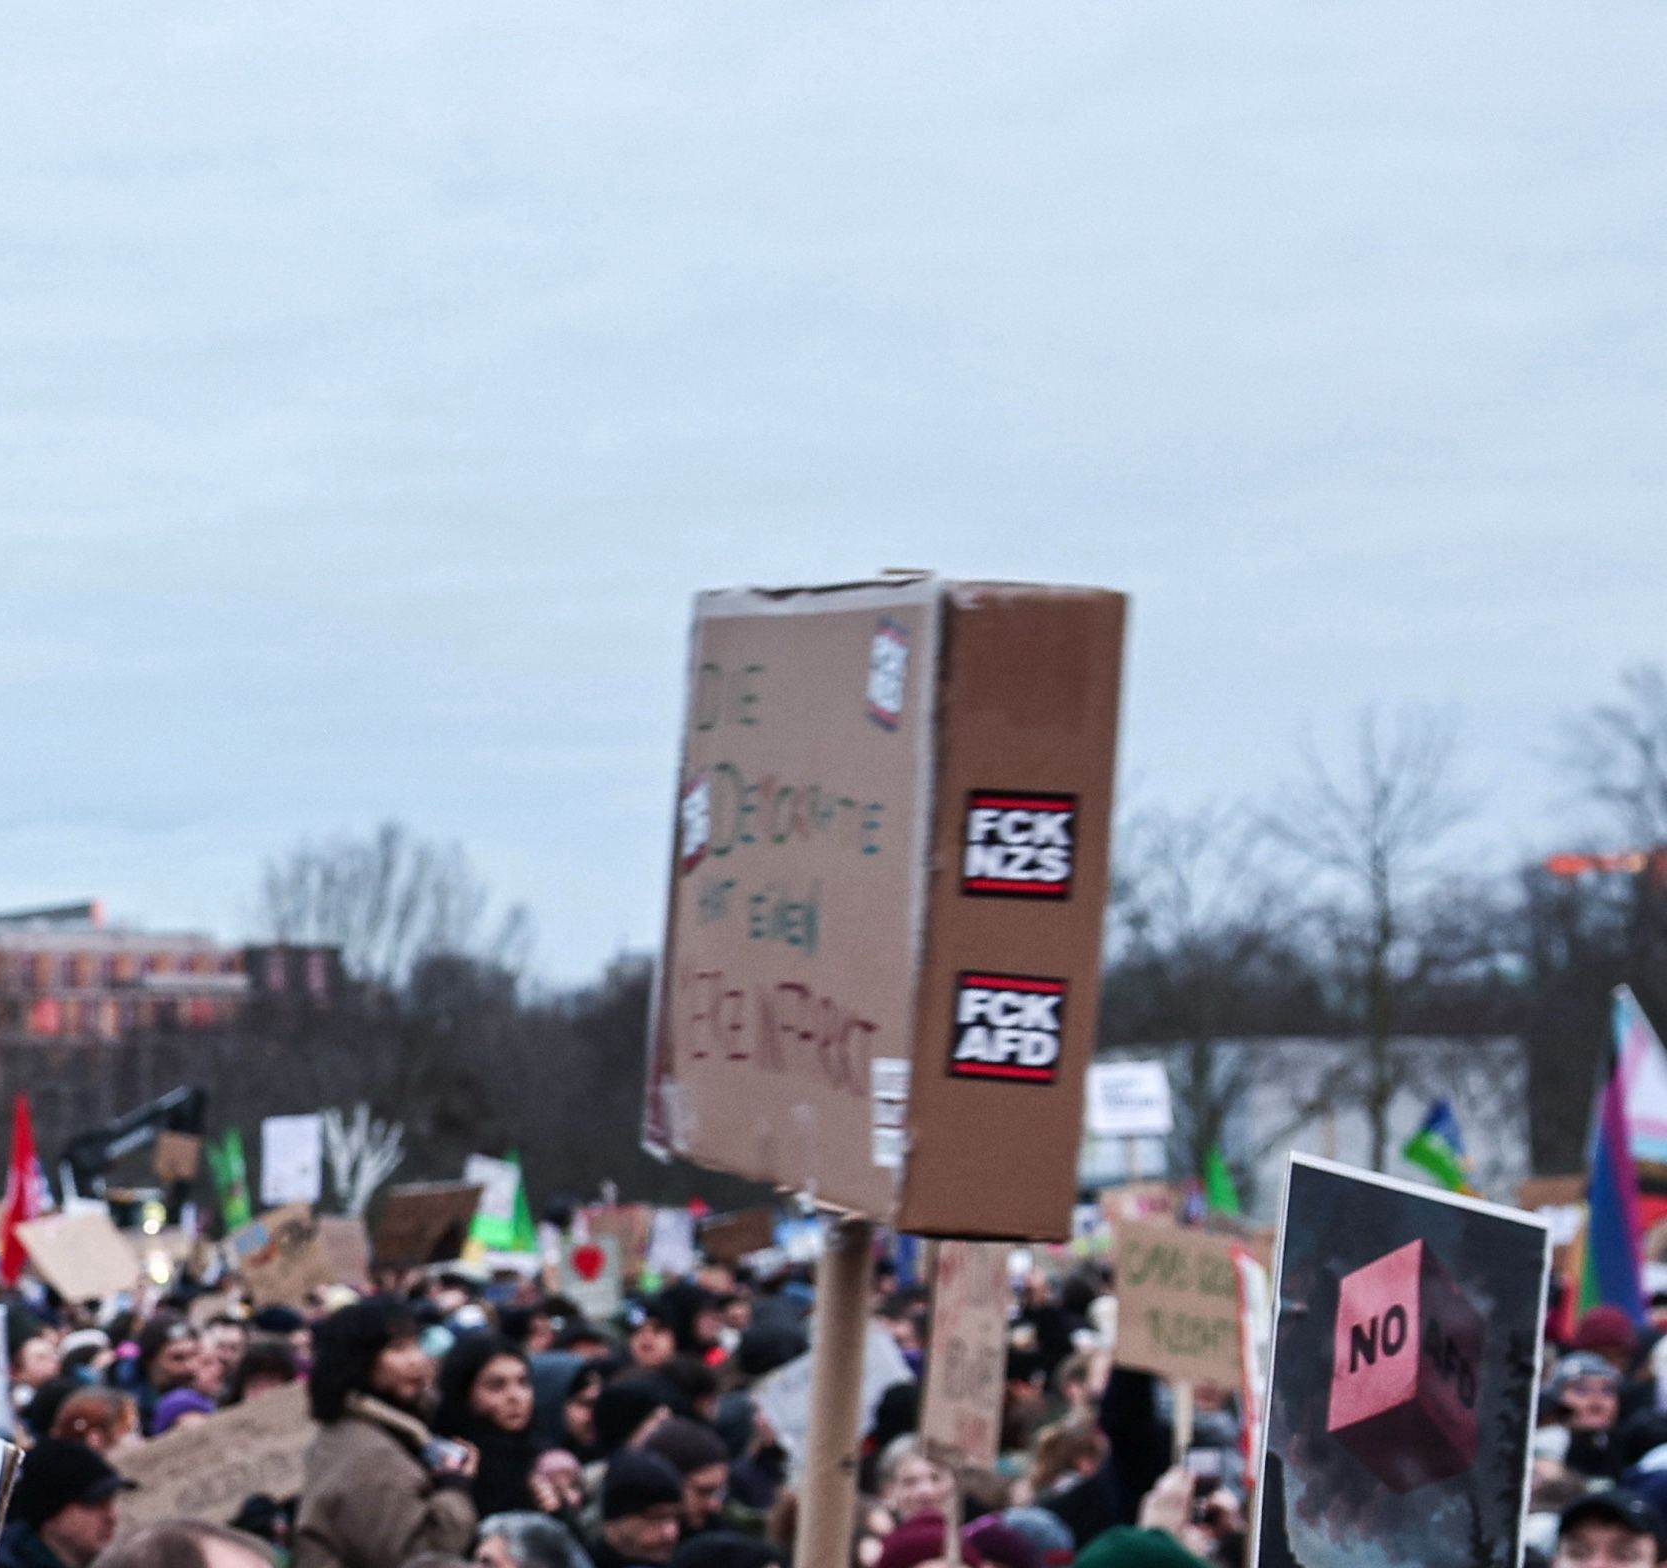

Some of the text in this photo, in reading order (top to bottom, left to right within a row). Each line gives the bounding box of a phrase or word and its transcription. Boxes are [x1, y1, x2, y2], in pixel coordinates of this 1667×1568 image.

[968, 808, 1074, 846] FCK
[964, 844, 1072, 882] NZS
[957, 987, 1062, 1031] FCK
[953, 1025, 1060, 1067] AFD
[1349, 1304, 1408, 1374] NO
[1425, 1318, 1477, 1409] AFD
